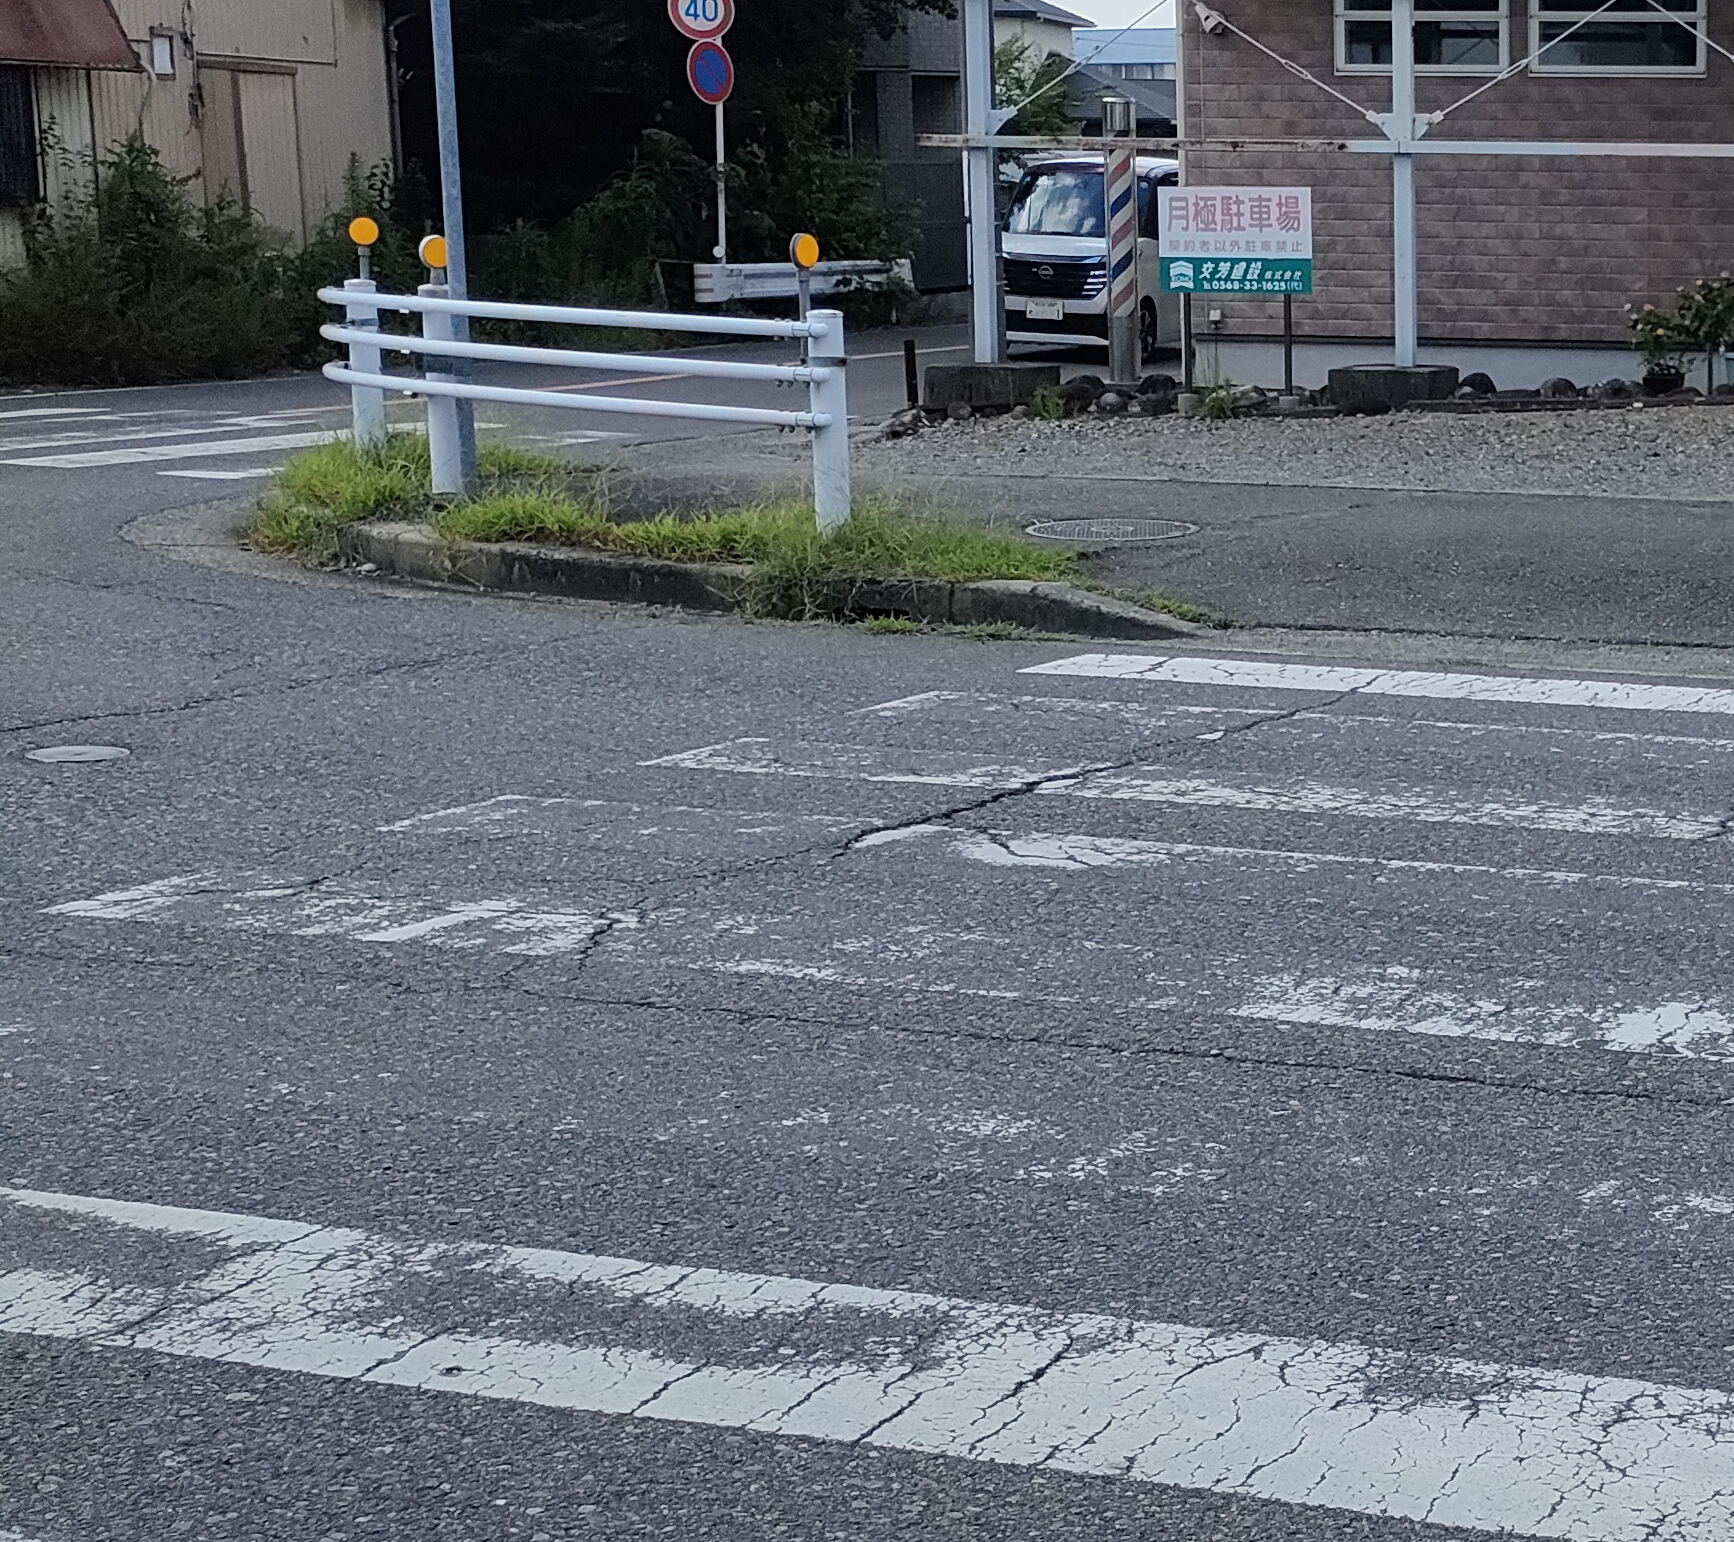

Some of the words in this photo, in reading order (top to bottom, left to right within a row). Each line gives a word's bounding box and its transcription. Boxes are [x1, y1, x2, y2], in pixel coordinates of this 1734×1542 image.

[1168, 194, 1302, 233] 月極駐車場
[1168, 240, 1303, 253] 契約者以外駐車禁止
